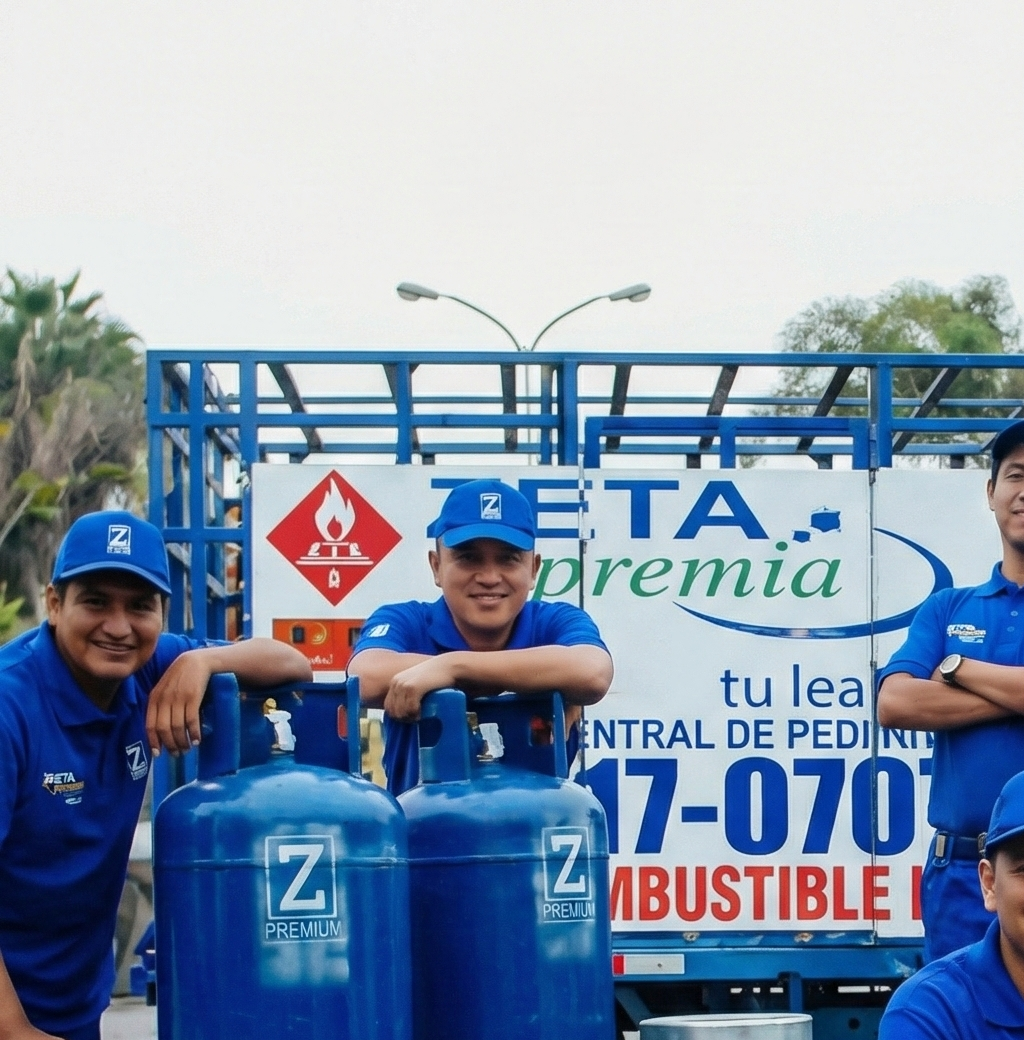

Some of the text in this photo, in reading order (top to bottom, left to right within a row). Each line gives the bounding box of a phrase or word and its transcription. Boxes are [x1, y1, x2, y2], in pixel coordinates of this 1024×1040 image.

[483, 496, 498, 512] Z
[110, 528, 128, 546] Z
[532, 542, 842, 601] premia
[720, 664, 864, 709] tu lea
[728, 720, 774, 749] DE
[127, 747, 146, 771] Z
[574, 756, 933, 856] 17-070
[279, 844, 326, 911] Z
[551, 835, 586, 893] Z
[265, 920, 342, 939] PREMIUM
